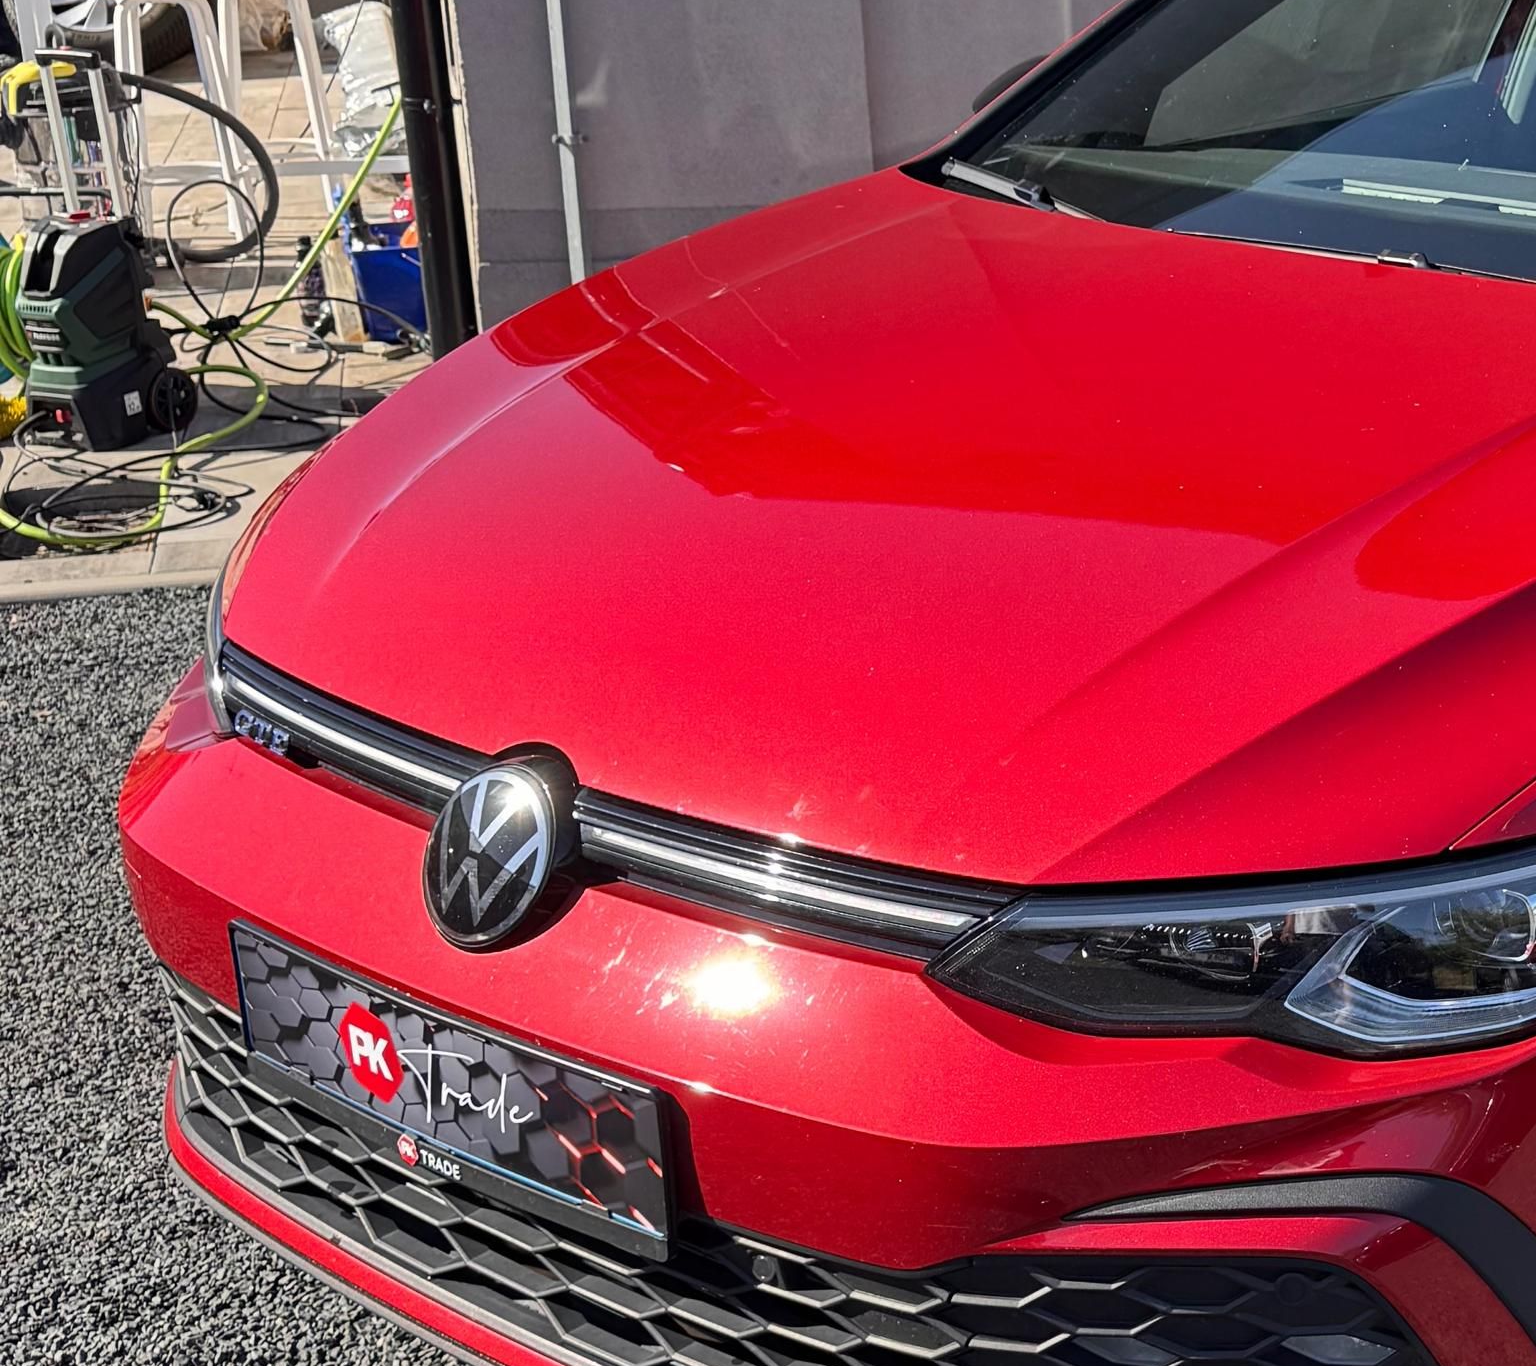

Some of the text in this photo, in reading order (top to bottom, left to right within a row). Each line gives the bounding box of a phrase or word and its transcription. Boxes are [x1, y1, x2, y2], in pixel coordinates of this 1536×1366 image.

[432, 769, 552, 933] VW
[348, 1023, 534, 1133] PK Trade
[420, 1149, 461, 1180] TRADE
